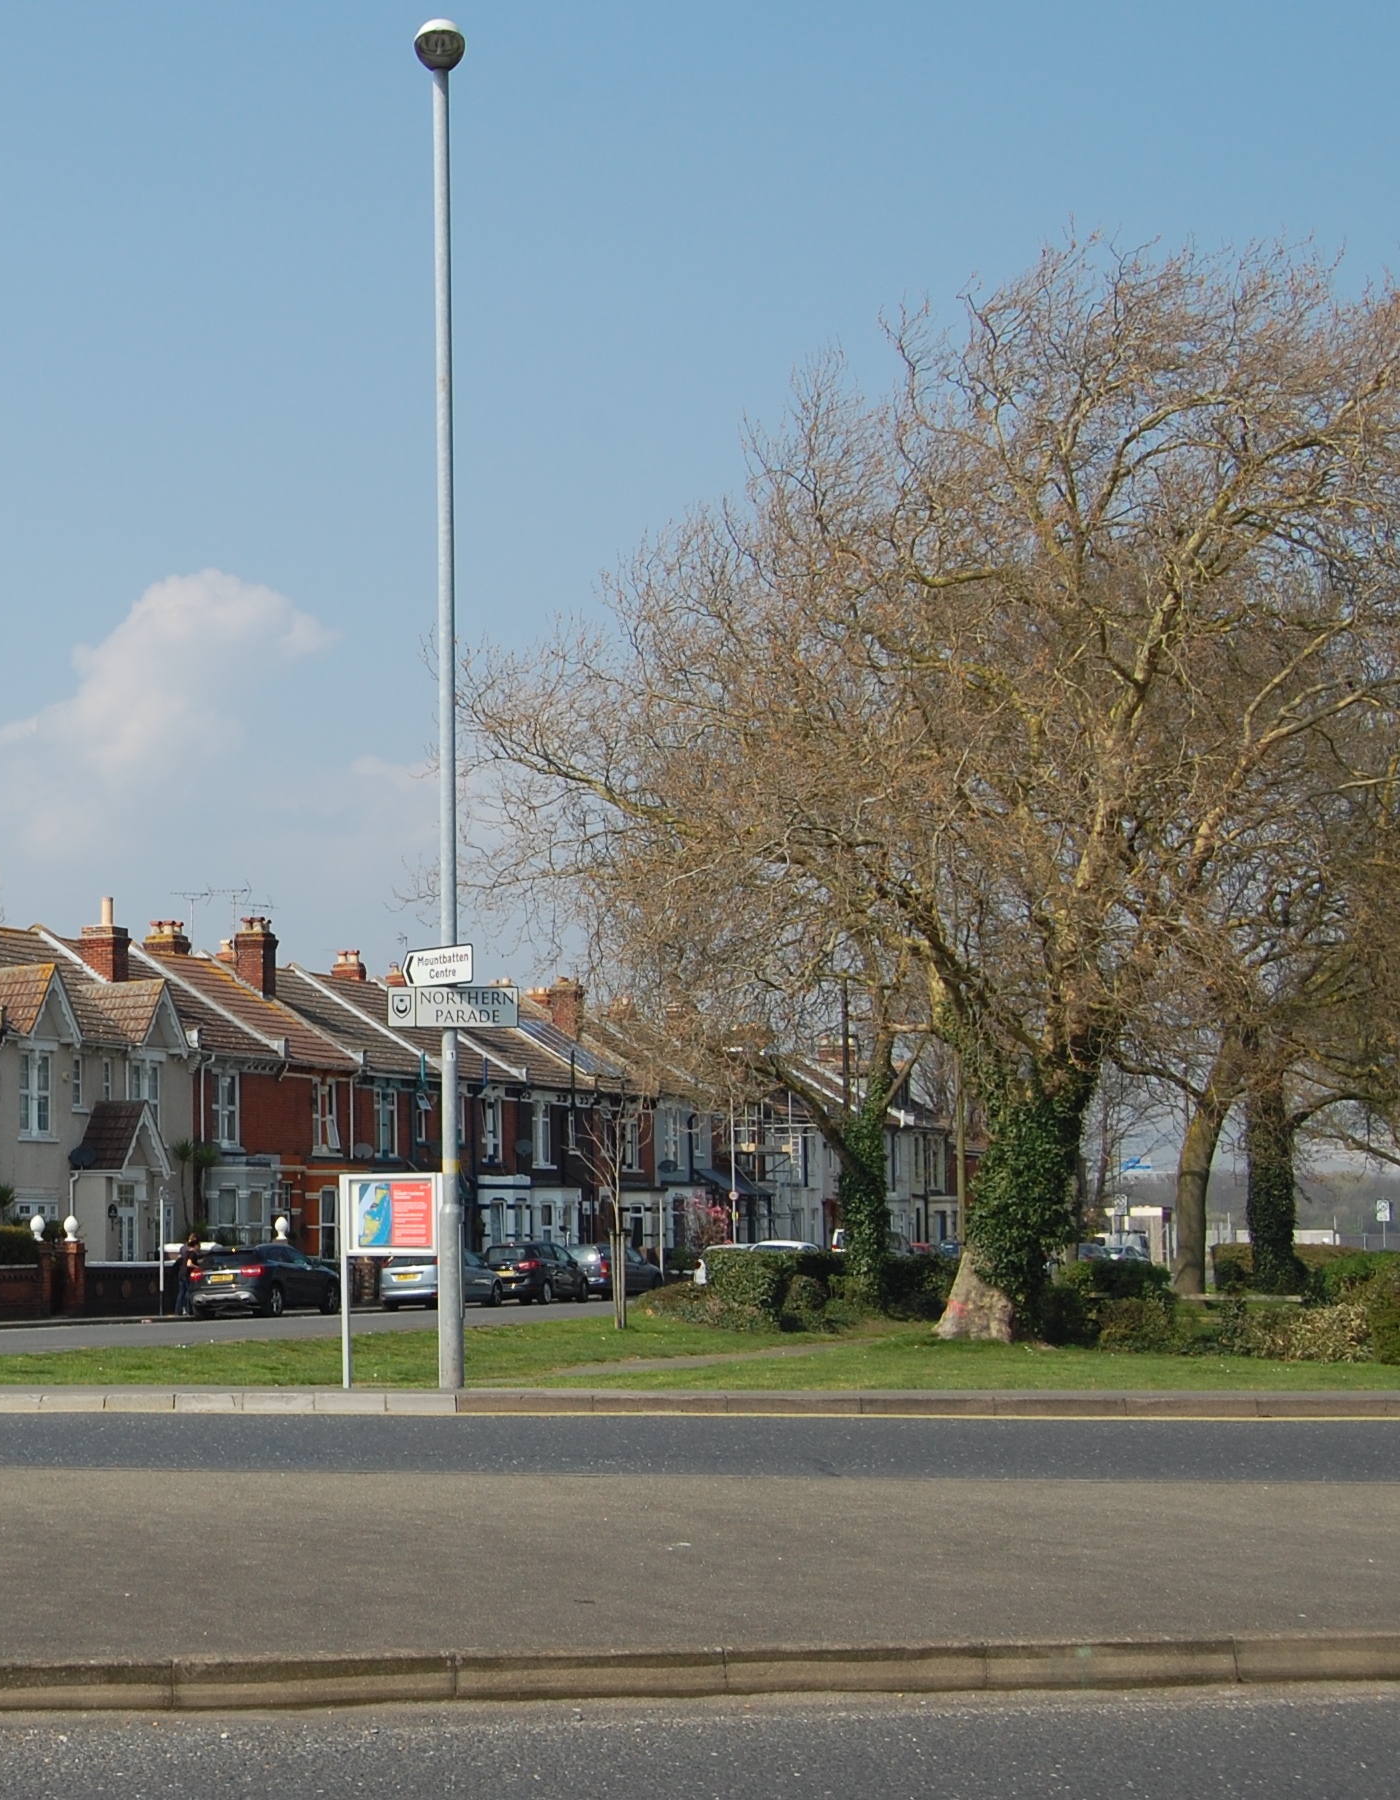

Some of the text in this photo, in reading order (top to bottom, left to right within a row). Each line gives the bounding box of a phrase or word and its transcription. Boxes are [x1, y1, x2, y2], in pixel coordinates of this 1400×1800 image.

[417, 952, 469, 967] Mountbatten
[429, 967, 457, 979] Centre
[420, 991, 514, 1005] NORTHERN
[435, 1009, 500, 1023] PARADE
